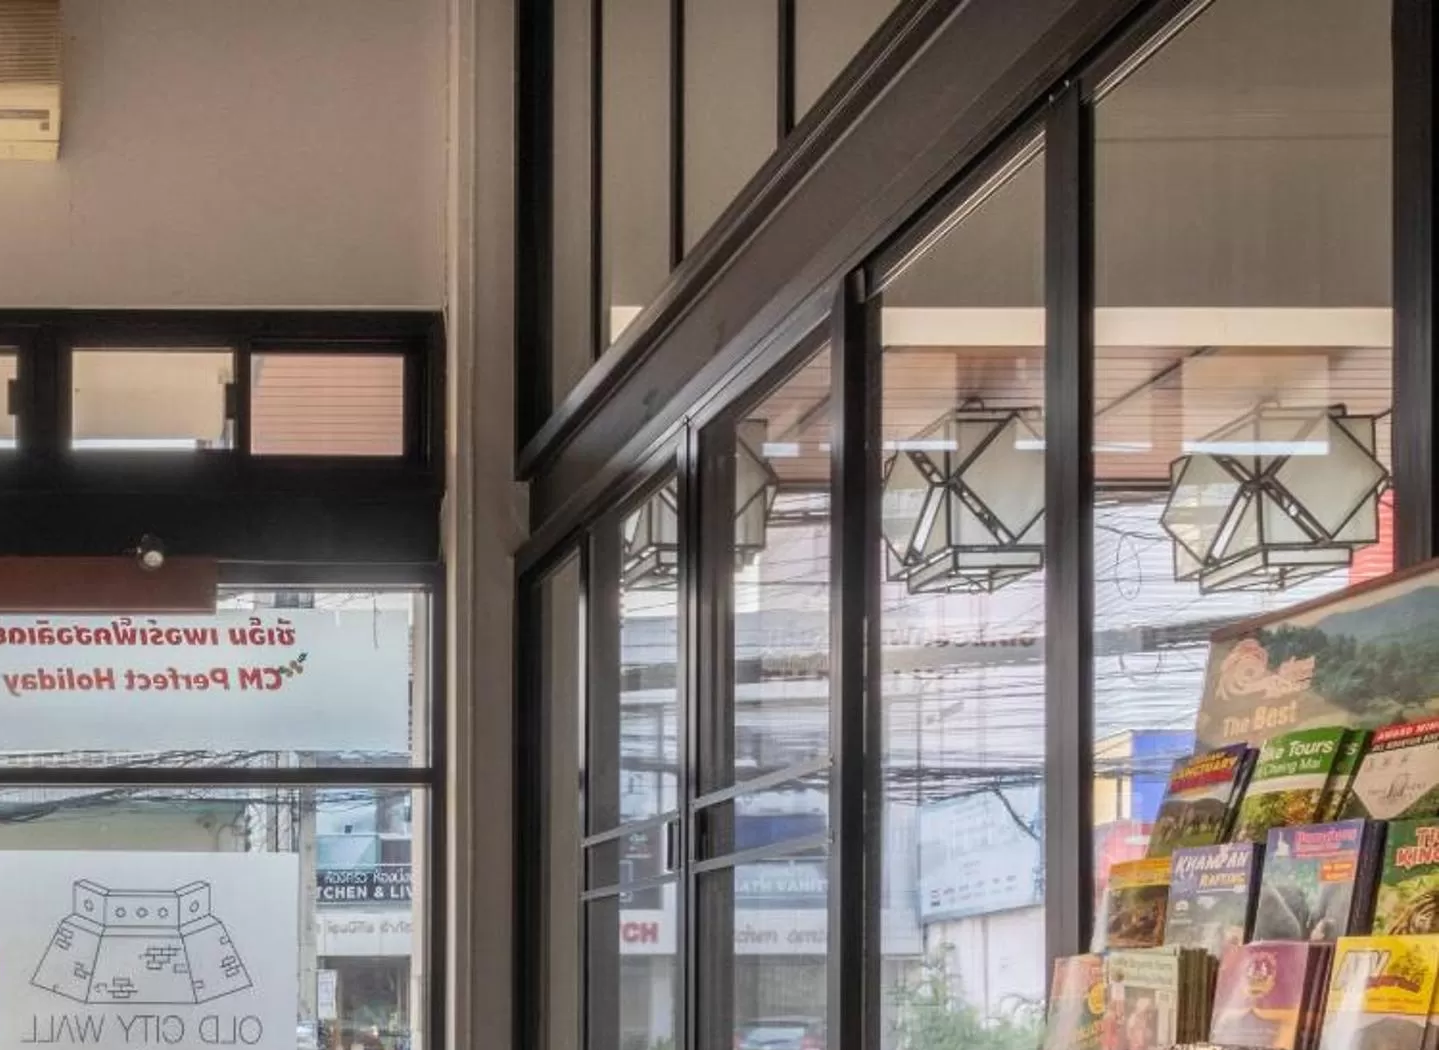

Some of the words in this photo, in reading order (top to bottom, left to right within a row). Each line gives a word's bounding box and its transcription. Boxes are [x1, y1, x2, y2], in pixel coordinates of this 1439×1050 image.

[1254, 700, 1297, 731] Best
[1288, 739, 1335, 759] Tours
[374, 886, 384, 898] &
